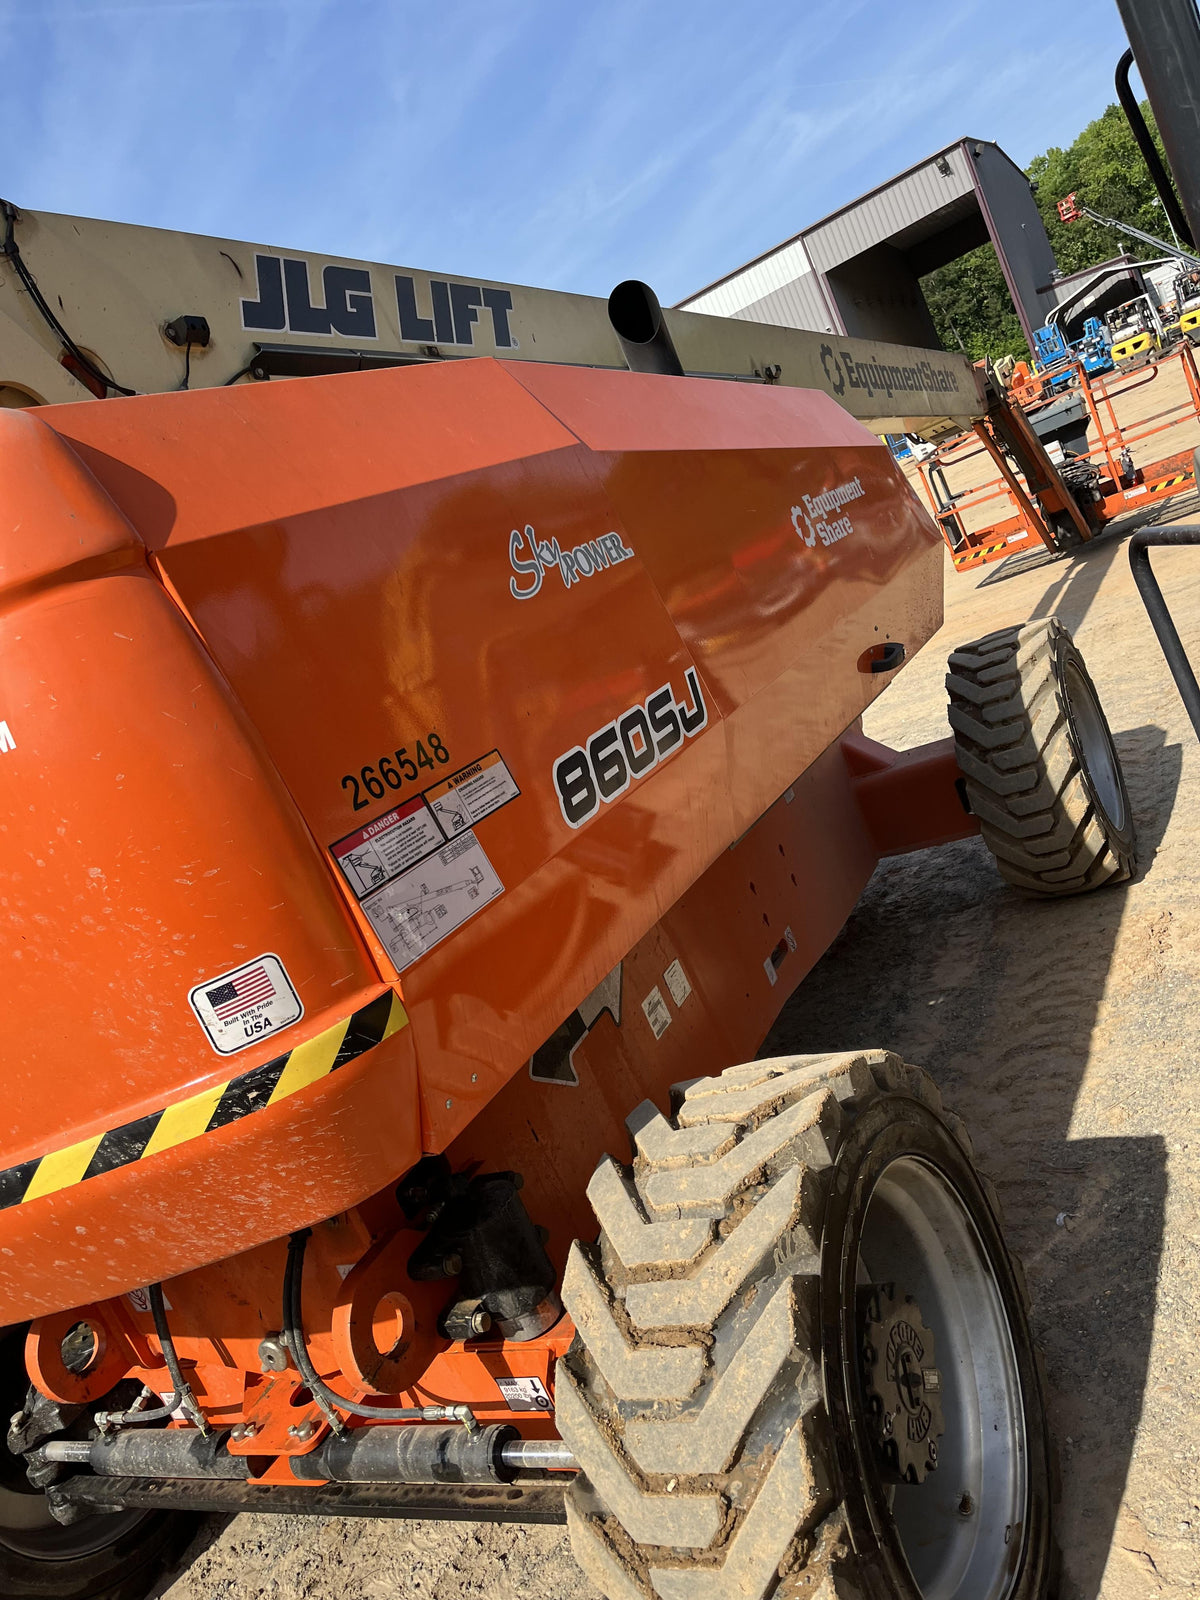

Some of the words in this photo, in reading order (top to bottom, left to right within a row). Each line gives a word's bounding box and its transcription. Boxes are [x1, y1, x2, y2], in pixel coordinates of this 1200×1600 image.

[241, 254, 379, 340] JLG
[839, 351, 959, 398] EquipmentShare
[802, 476, 866, 519] Equipment
[816, 516, 854, 547] Share
[553, 666, 707, 828] 860SJ
[341, 733, 450, 811] 266548
[452, 764, 482, 785] WARNING
[367, 812, 400, 836] DANGER
[223, 1016, 239, 1027] Built
[240, 1008, 256, 1019] With
[257, 1000, 274, 1011] Pride
[244, 1017, 273, 1037] USA
[250, 1013, 263, 1023] The
[907, 1401, 932, 1443] HUB
